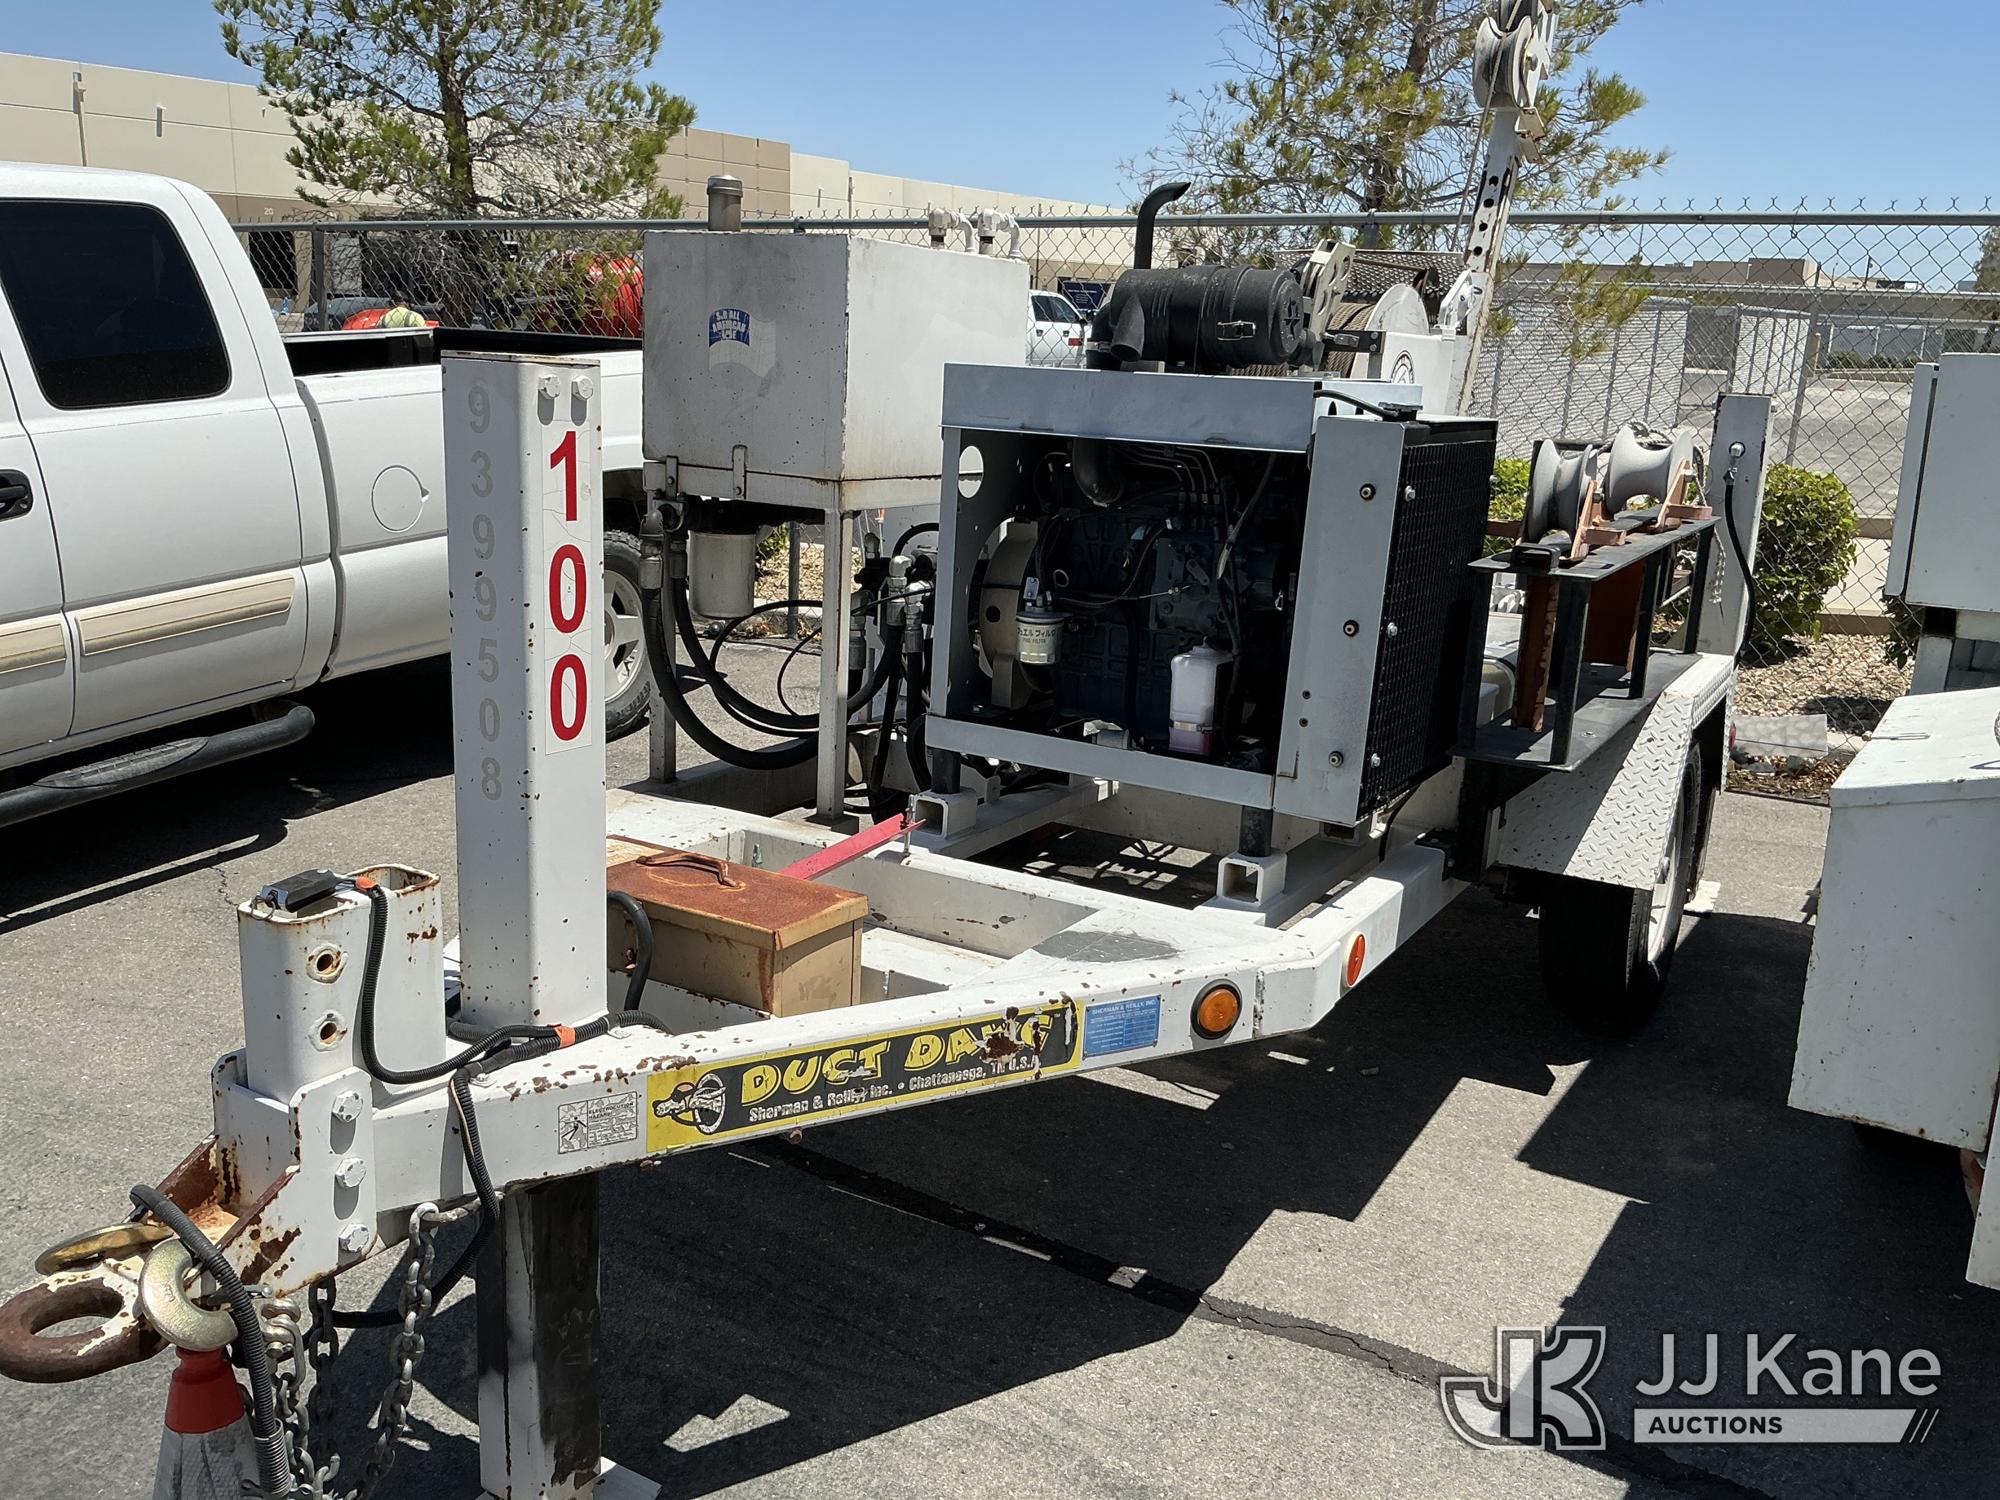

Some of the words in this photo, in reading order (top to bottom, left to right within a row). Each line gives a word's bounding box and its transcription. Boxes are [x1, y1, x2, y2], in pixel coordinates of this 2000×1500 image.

[549, 430, 588, 742] 100
[741, 1041, 891, 1107] DUCT
[749, 1098, 809, 1122] Sherman
[812, 1095, 824, 1110] &
[870, 1084, 893, 1099] Inc.
[909, 1066, 986, 1091] Chattanooga,
